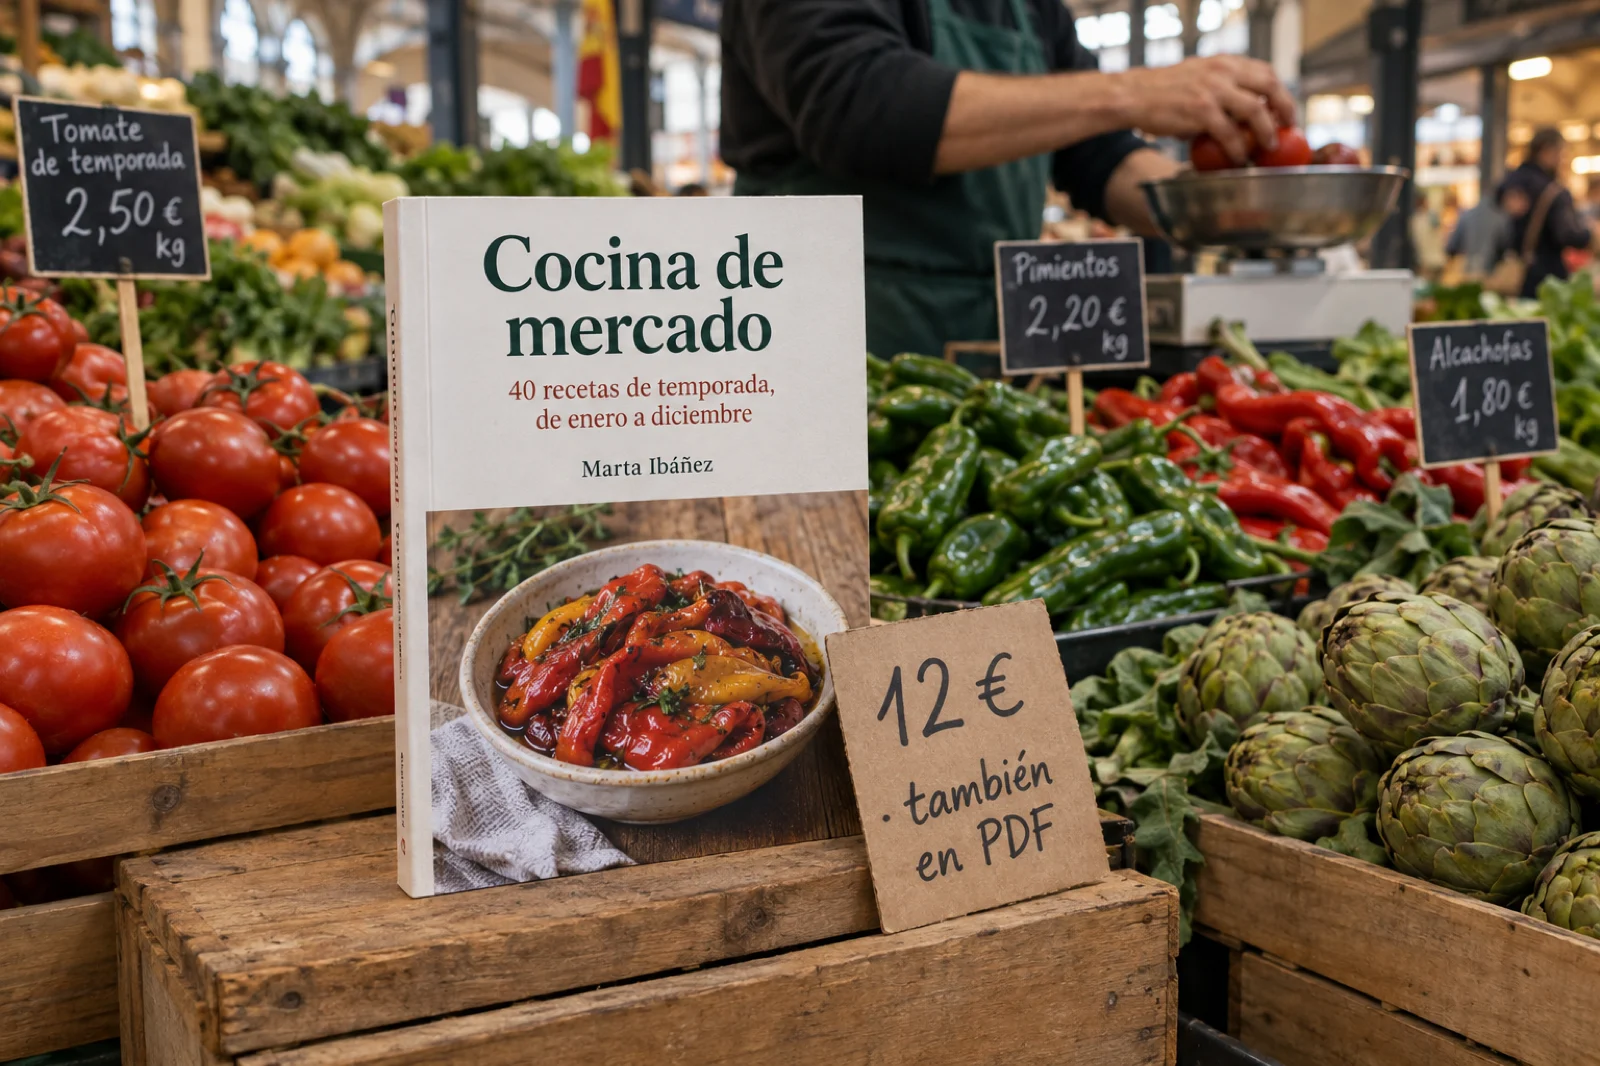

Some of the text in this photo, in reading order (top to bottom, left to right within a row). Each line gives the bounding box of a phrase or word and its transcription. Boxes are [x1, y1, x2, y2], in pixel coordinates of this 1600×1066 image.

[40, 113, 144, 144] Tomate
[31, 141, 186, 182] de temporada
[62, 187, 183, 246] 2,50 €
[156, 231, 185, 268] kg
[483, 233, 784, 293] Cocina de
[1012, 249, 1119, 285] Pimientos
[506, 296, 772, 357] mercado
[1025, 294, 1127, 342] 2,20 €
[1102, 329, 1128, 360] kg
[1429, 329, 1533, 371] Alcachofas
[508, 373, 775, 402] 40 recetas de temporada,
[1450, 376, 1533, 428] 1,80 €
[536, 403, 753, 430] de enero a diciembre
[1514, 413, 1539, 447] kg
[581, 456, 714, 478] Marta Ibáñez
[877, 652, 1024, 747] 12 €
[903, 749, 1054, 826] también
[916, 802, 1054, 882] en PDF
